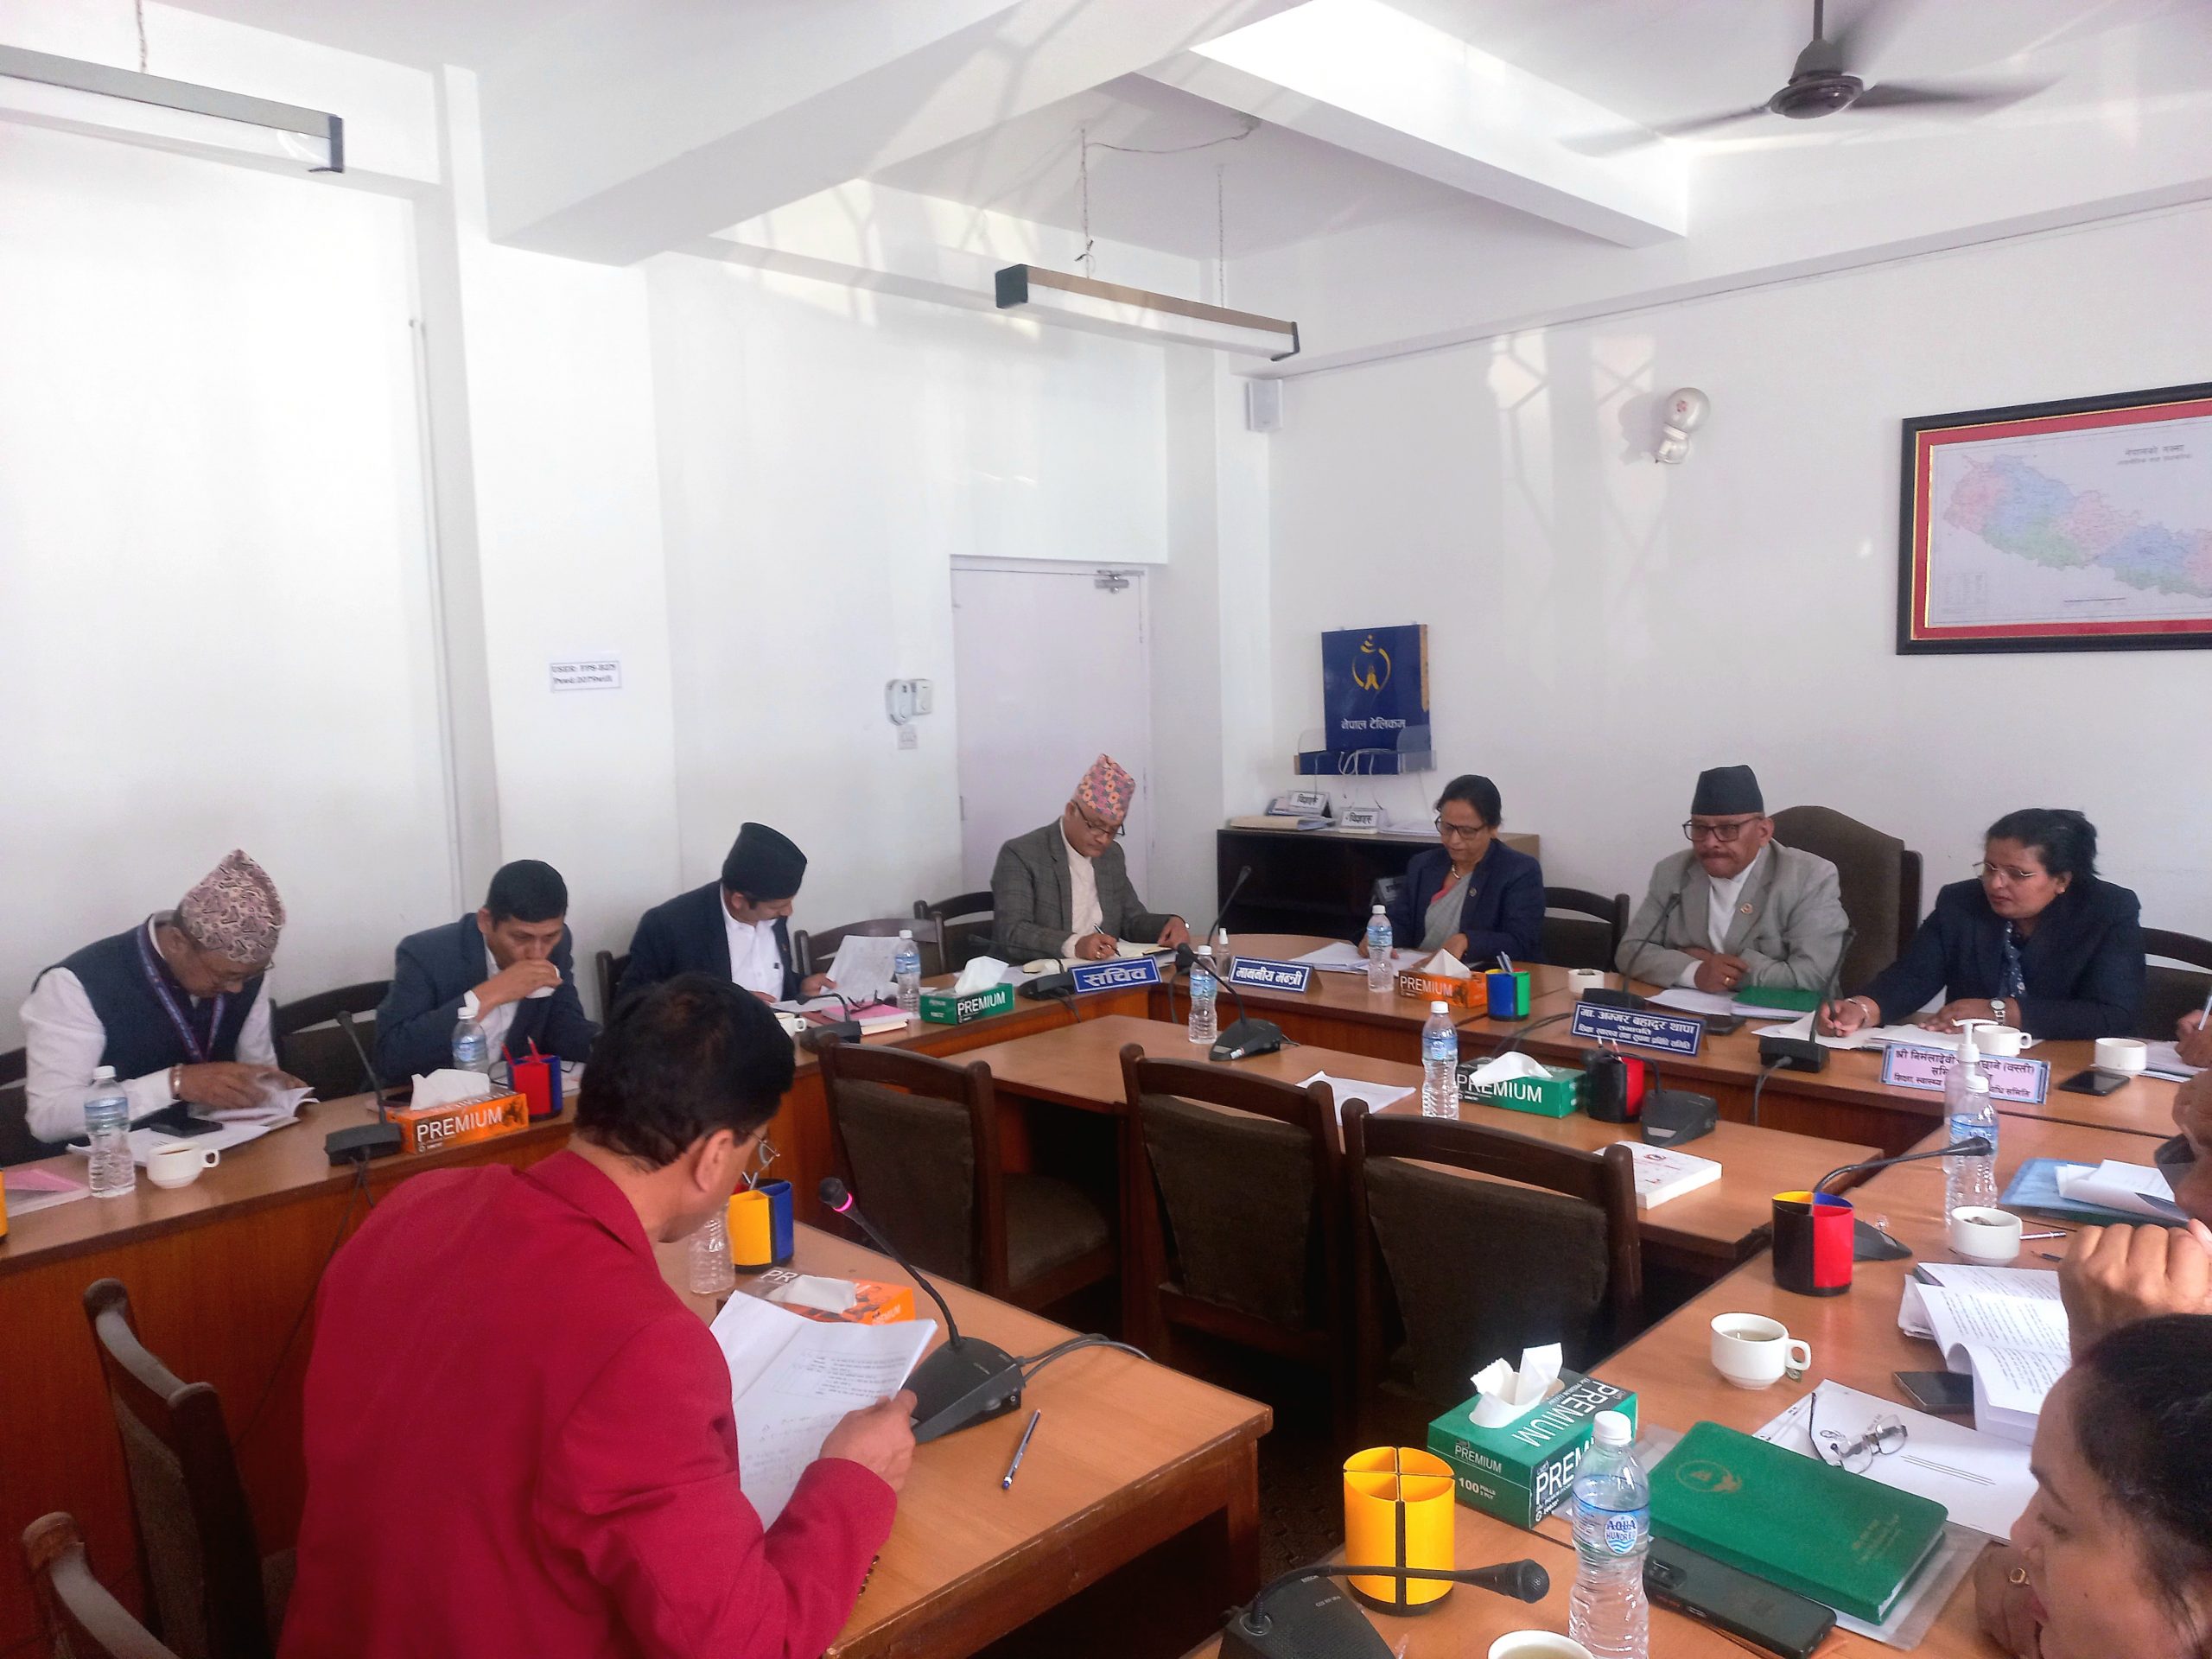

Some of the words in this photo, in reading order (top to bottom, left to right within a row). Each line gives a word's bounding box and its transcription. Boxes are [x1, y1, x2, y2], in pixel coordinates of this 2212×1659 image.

[1341, 718, 1367, 729] नेपाल
[1369, 716, 1407, 729] टेलिकम
[1083, 967, 1147, 987] सचिव
[1236, 966, 1275, 982] माननीय
[1275, 970, 1304, 985] मन्त्री
[1401, 976, 1453, 997] PREMIUM
[957, 990, 1006, 1016] PREMIUM
[1632, 1016, 1668, 1030] बहादुर
[1669, 1021, 1696, 1034] थापा
[1456, 1073, 1542, 1103] PREMIUM
[416, 1106, 502, 1142] PREMIUM
[1511, 1380, 1620, 1447] PREMIUM
[1454, 1445, 1503, 1473] PREMIUM
[1459, 1477, 1479, 1494] 100
[1606, 1520, 1637, 1532] AQUA
